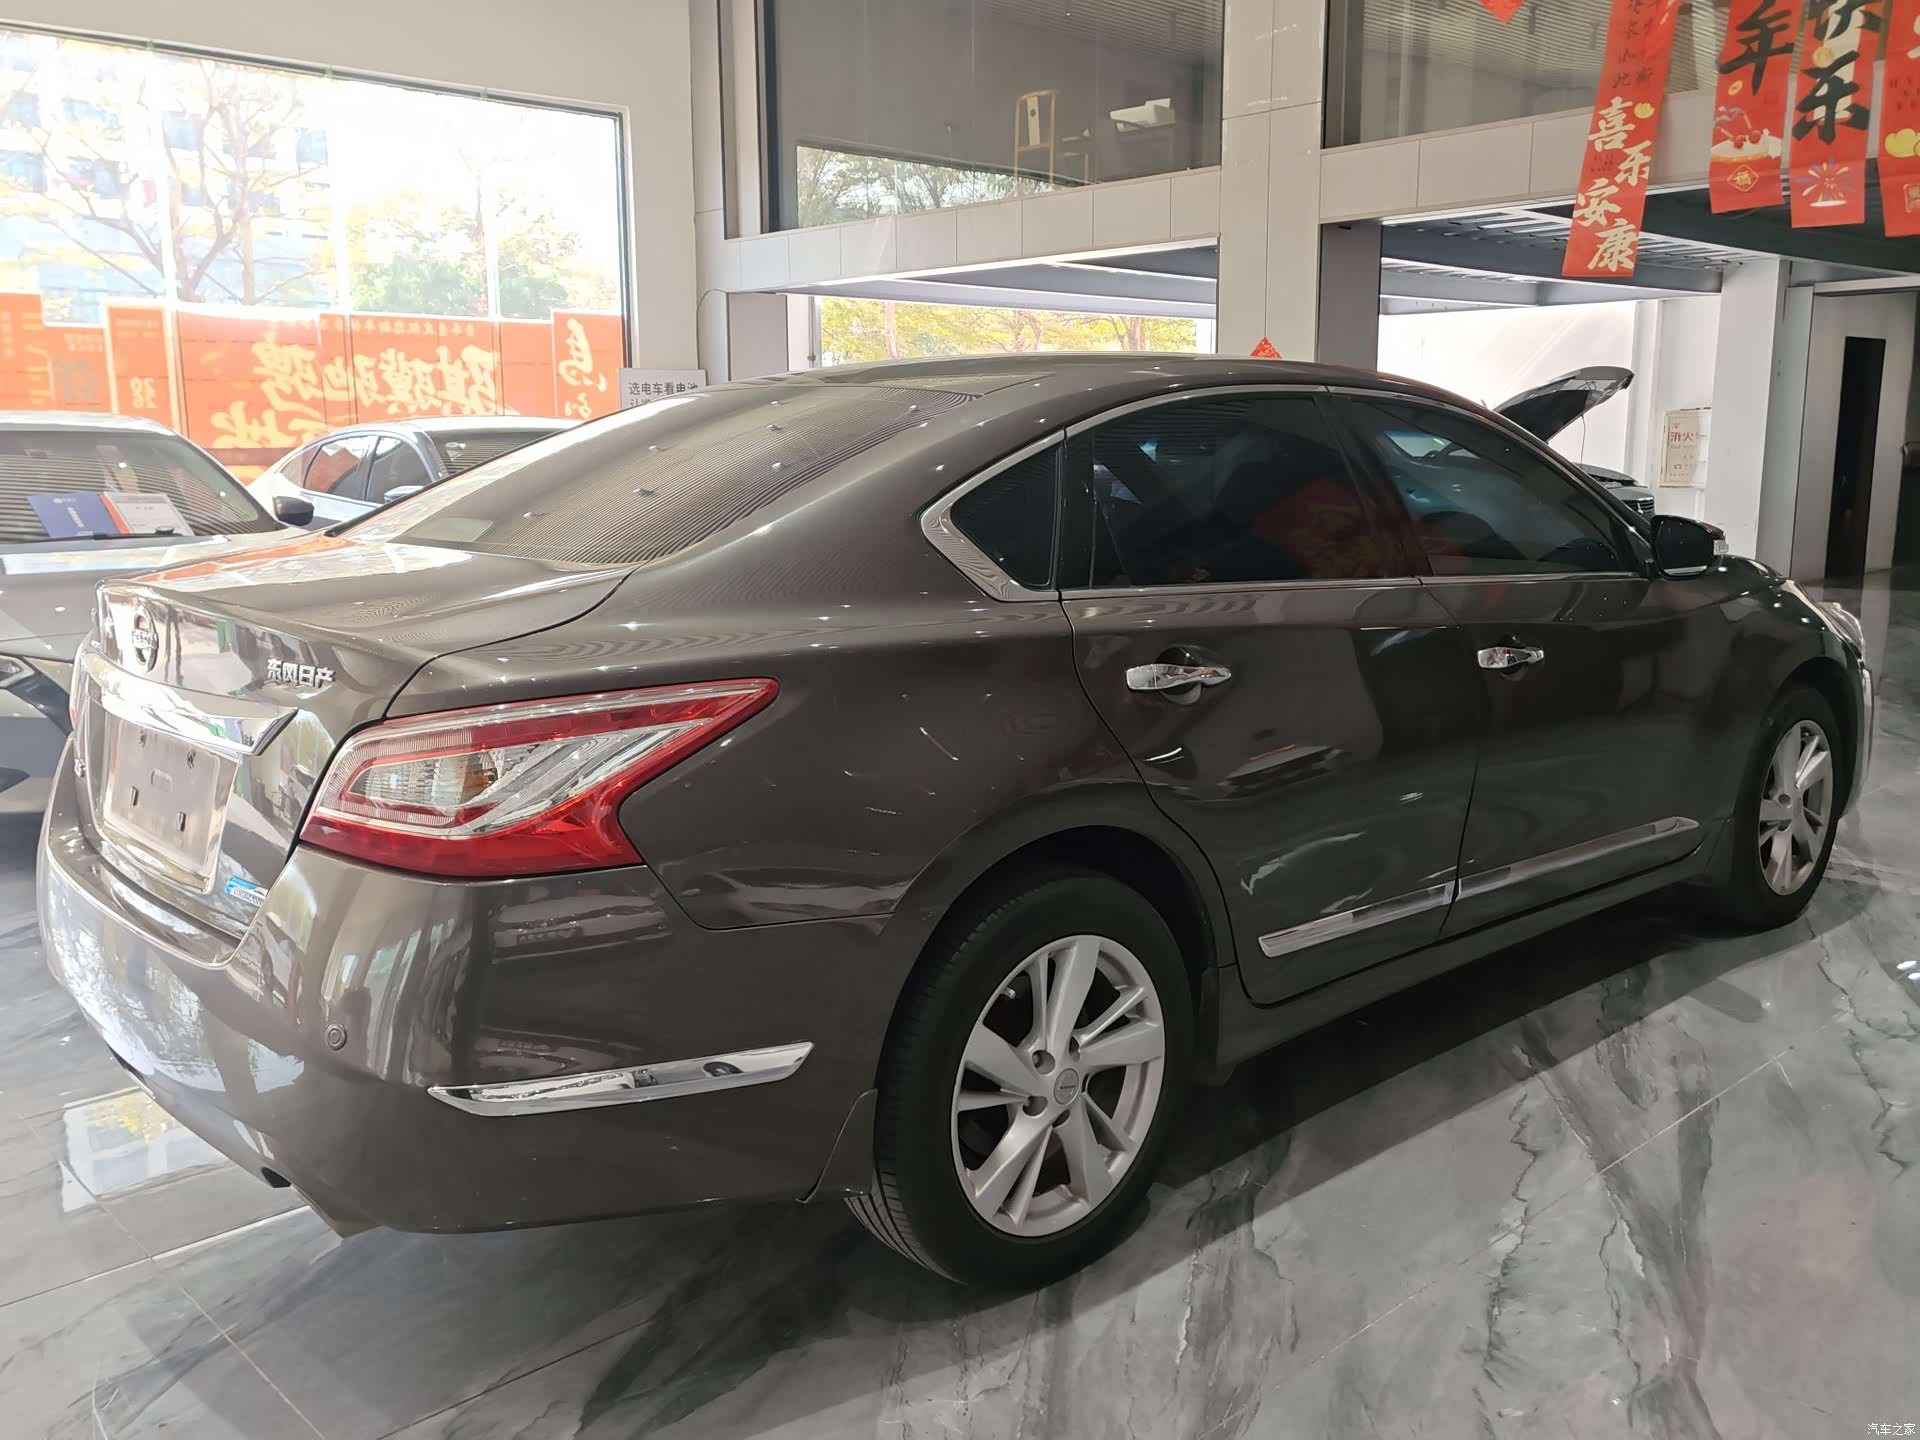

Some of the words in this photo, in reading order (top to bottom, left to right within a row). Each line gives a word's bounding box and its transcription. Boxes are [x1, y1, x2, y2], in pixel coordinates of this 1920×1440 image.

[1573, 96, 1652, 272] 喜乐安康
[266, 658, 335, 688] 东风日产
